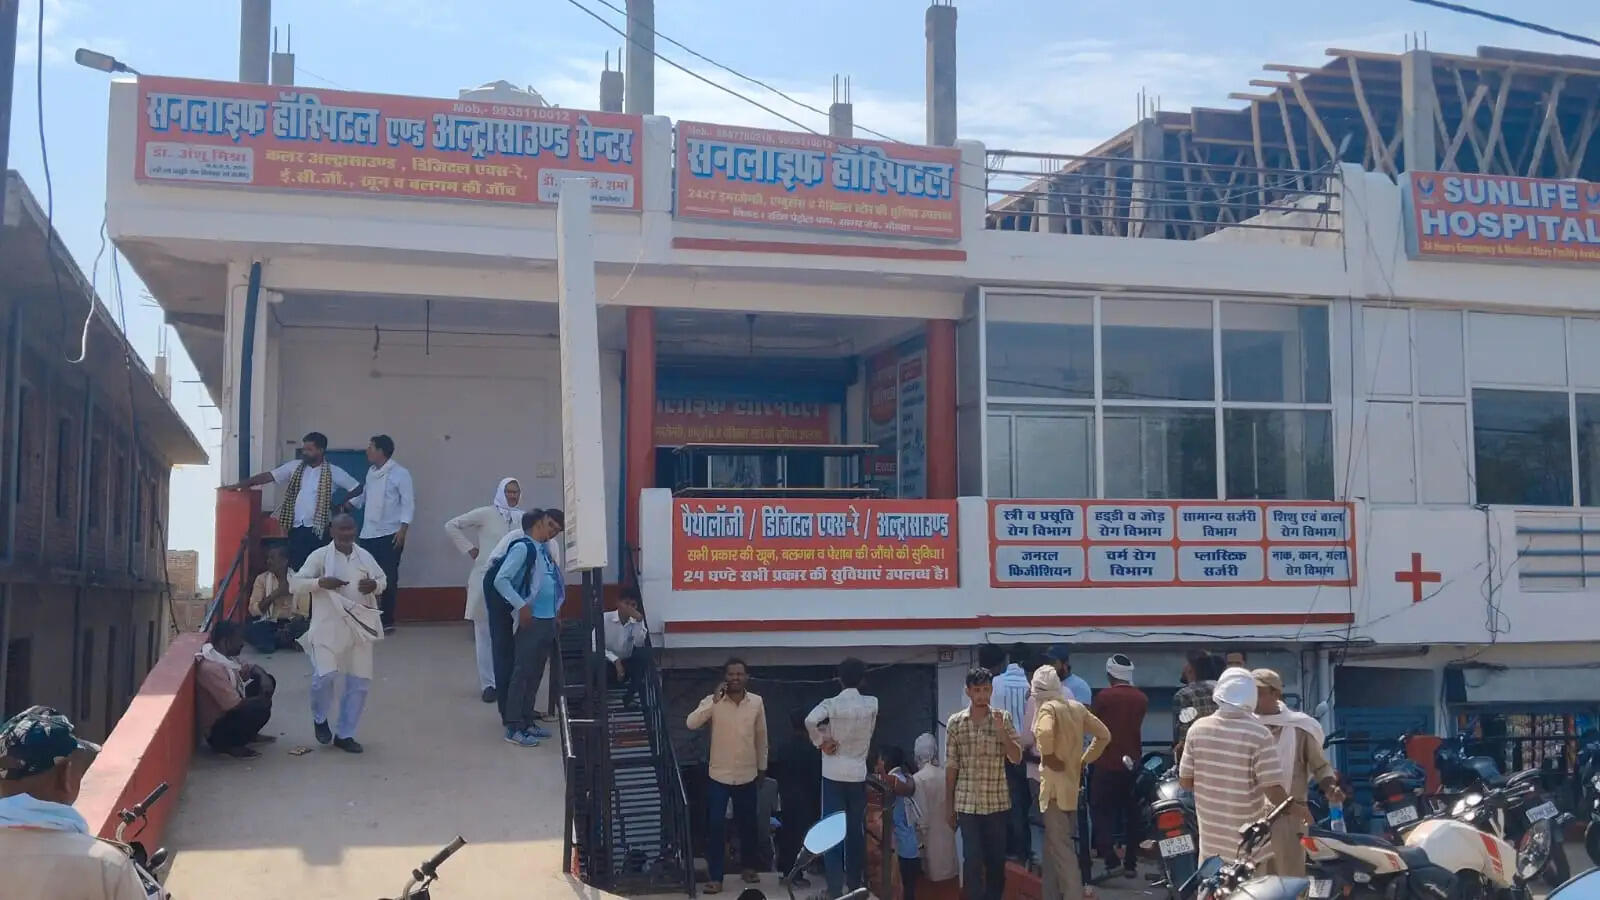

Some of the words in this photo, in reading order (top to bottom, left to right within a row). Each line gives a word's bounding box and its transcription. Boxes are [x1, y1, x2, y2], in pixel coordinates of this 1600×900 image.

[147, 91, 269, 143] सनलाइफ
[272, 91, 381, 145] हॉस्पिटल
[384, 116, 427, 148] एण्ड
[576, 114, 634, 164] सेन्टर
[265, 149, 304, 163] कलर
[412, 156, 471, 175] डिजिटल
[687, 137, 826, 192] सनलाइफ
[830, 143, 954, 198] हॉस्पिटल
[462, 179, 481, 194] की
[1442, 175, 1580, 210] SUNLIFE
[1420, 208, 1600, 244] HOSPITAL
[680, 503, 744, 537] पैथोलॉजी
[762, 505, 814, 537] डिजिटल
[817, 504, 860, 537] एक्स-रे
[876, 512, 949, 541] अल्ट्रासाउण्ड
[1003, 508, 1023, 521] स्त्री
[1027, 510, 1036, 521] व
[1039, 508, 1075, 524] प्रसूति
[1127, 511, 1137, 521] व
[1182, 511, 1223, 523] सामान्य
[1226, 509, 1257, 523] सर्जरी
[1273, 510, 1299, 525] शिशु
[1301, 509, 1318, 522] एवं
[1007, 525, 1029, 537] रोग
[1033, 524, 1072, 537] विभाग
[1099, 525, 1120, 537] रोग
[1123, 524, 1162, 537] विभाग
[1203, 525, 1237, 537] विभाग
[1281, 525, 1299, 537] रोग
[1303, 525, 1337, 537] विभाग
[687, 545, 709, 561] सभी
[711, 549, 738, 562] प्रकार
[739, 545, 755, 561] की
[817, 549, 825, 560] व
[855, 544, 868, 560] की
[896, 544, 909, 560] की
[1021, 550, 1059, 561] जनरल
[1105, 548, 1129, 561] चर्म
[1132, 548, 1157, 561] रोग
[683, 569, 704, 583] 24
[708, 566, 737, 582] घण्टे
[740, 566, 768, 582] सभी
[772, 569, 807, 583] प्रकार
[809, 566, 828, 581] की
[885, 568, 930, 581] उपलब्ध
[1008, 564, 1072, 577] फिजीशियन
[1110, 563, 1154, 576] विभाग
[1203, 563, 1239, 577] सर्जरी
[1285, 564, 1302, 576] रोग
[1304, 563, 1335, 576] विभाग
